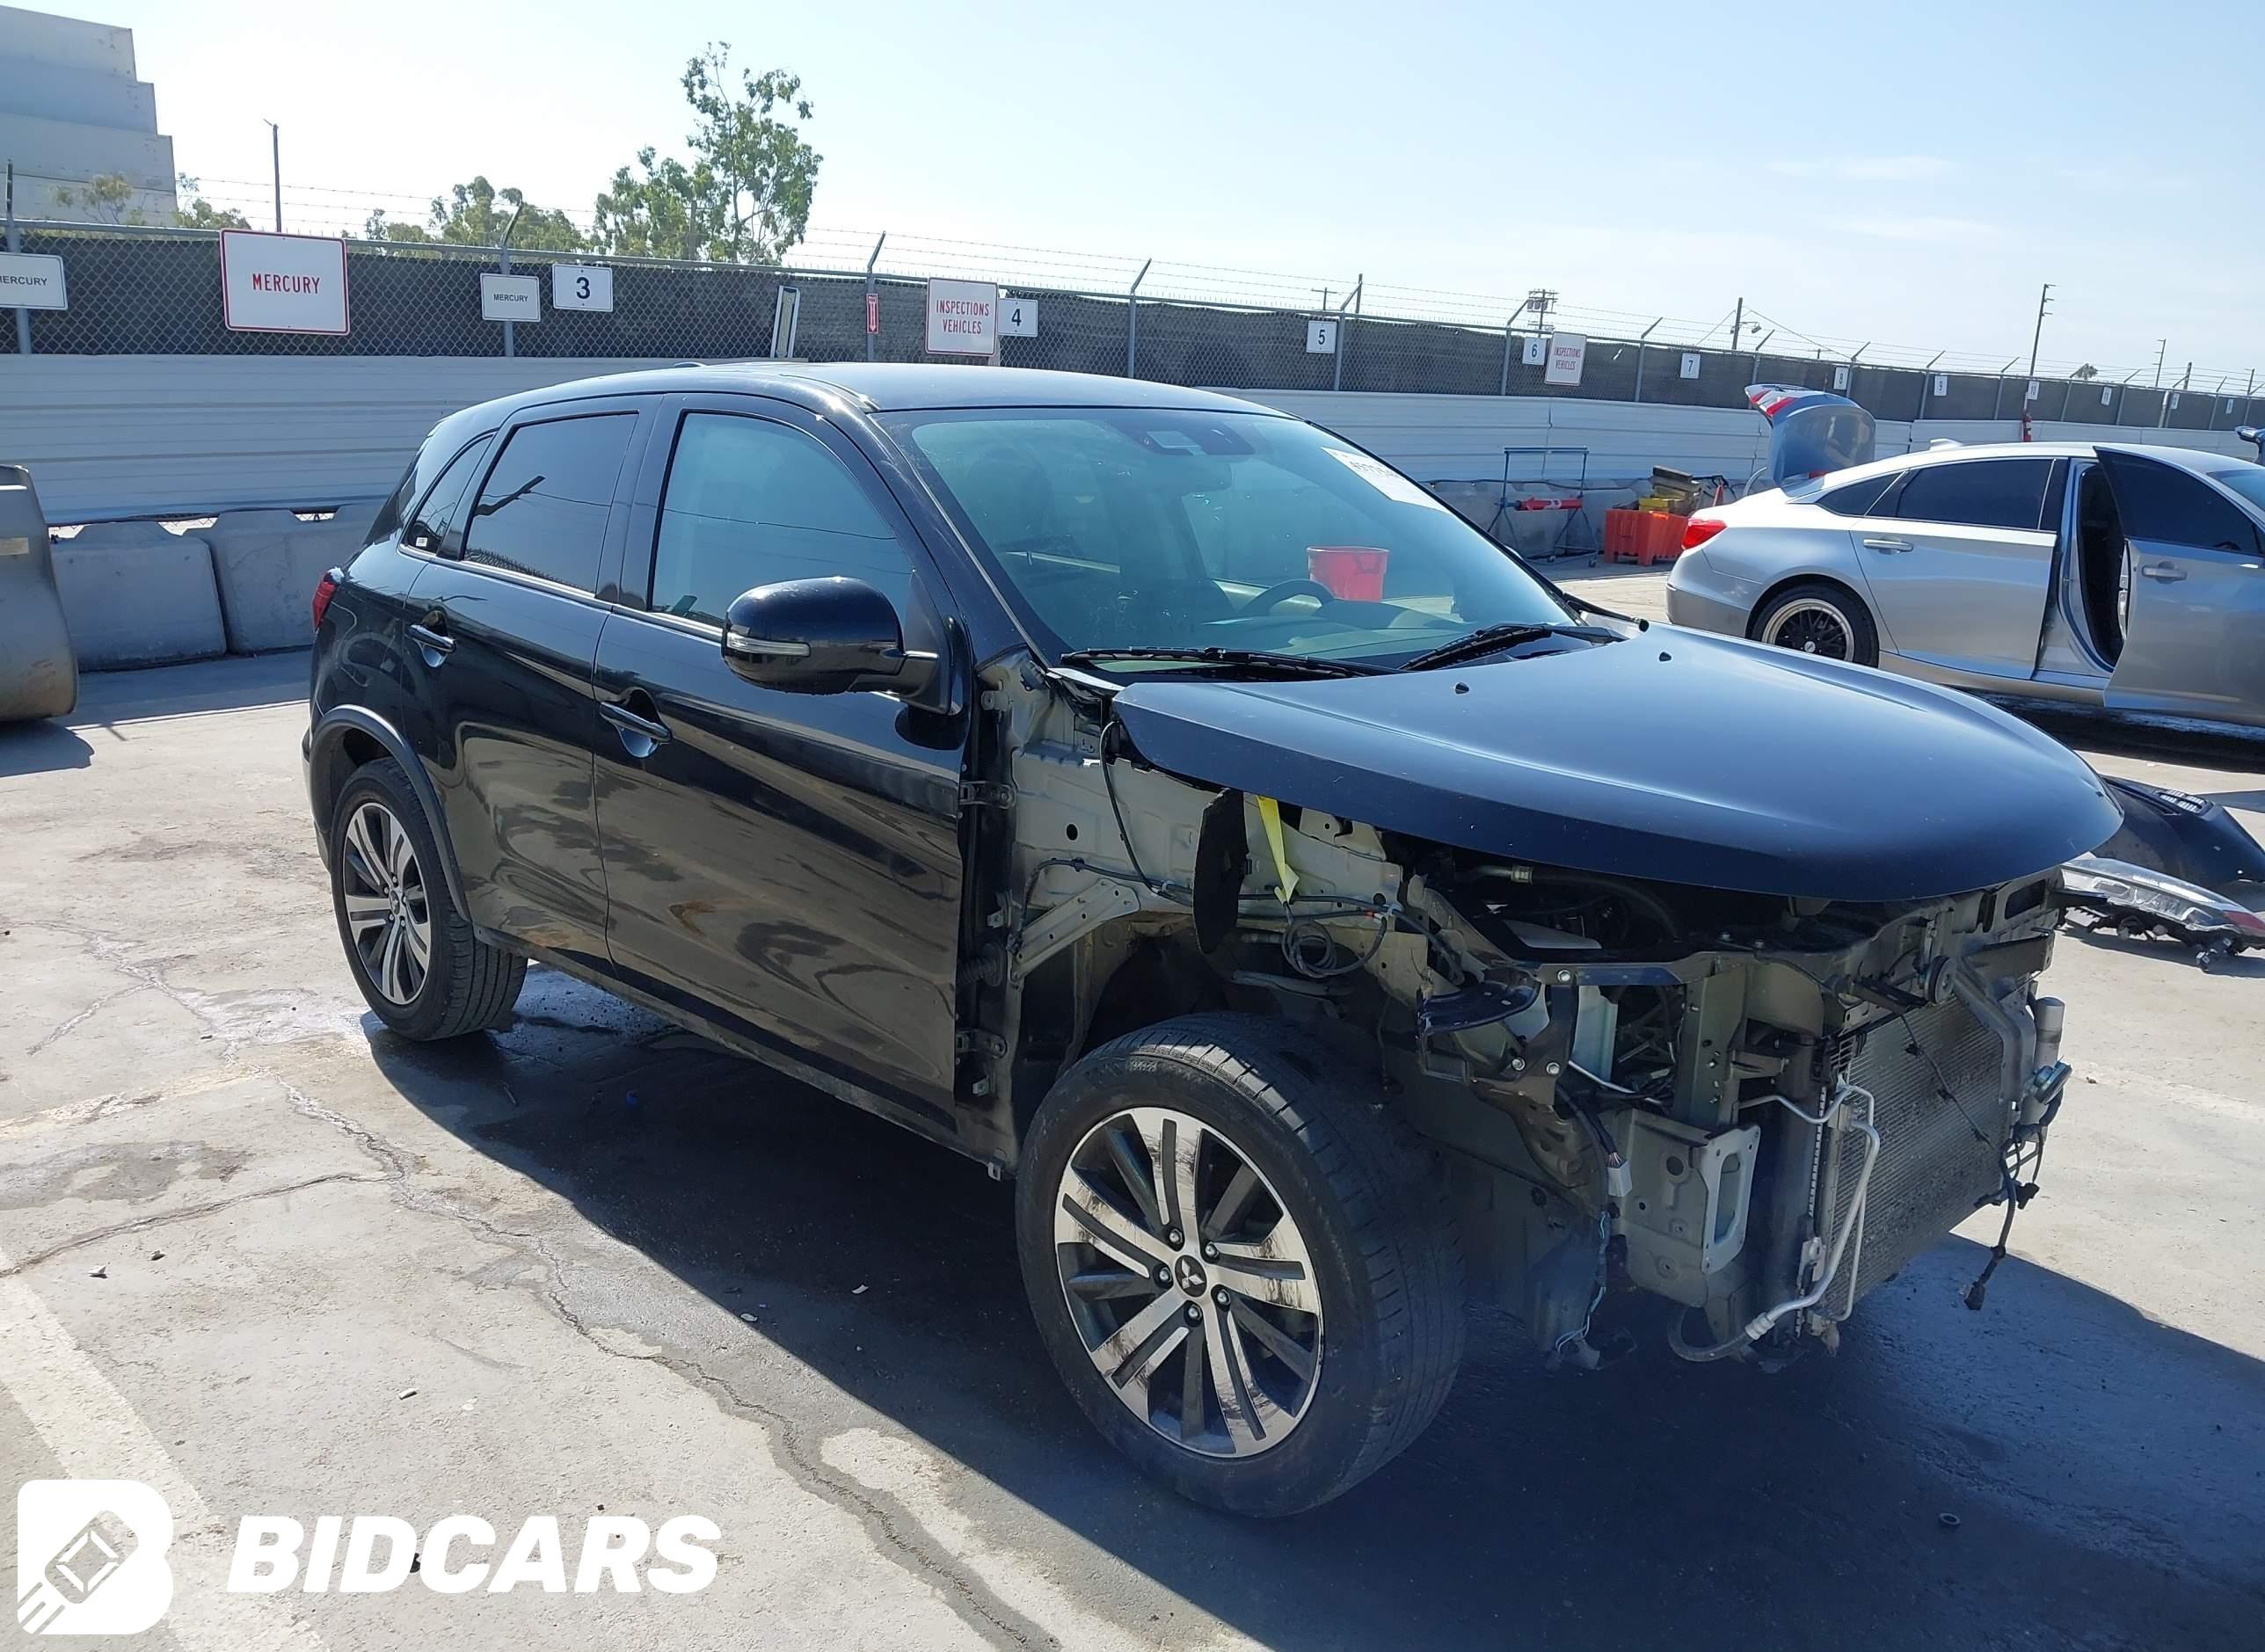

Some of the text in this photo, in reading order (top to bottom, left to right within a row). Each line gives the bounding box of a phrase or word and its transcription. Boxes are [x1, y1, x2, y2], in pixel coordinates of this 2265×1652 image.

[0, 275, 47, 287] ERCURY
[252, 273, 320, 295] MERCURY
[576, 276, 591, 300] 3
[493, 294, 528, 302] MERCURY
[936, 300, 990, 317] INSPECTIONS
[1011, 308, 1022, 327] 4
[943, 319, 982, 334] VEHICLES
[1318, 329, 1326, 346] 5
[1531, 344, 1538, 358] 6
[1554, 346, 1581, 359] INSPECTIONS
[1555, 359, 1577, 370] VEHICLES
[1688, 360, 1693, 373] 7
[1839, 373, 1844, 384] 8
[1939, 380, 1943, 391] 9
